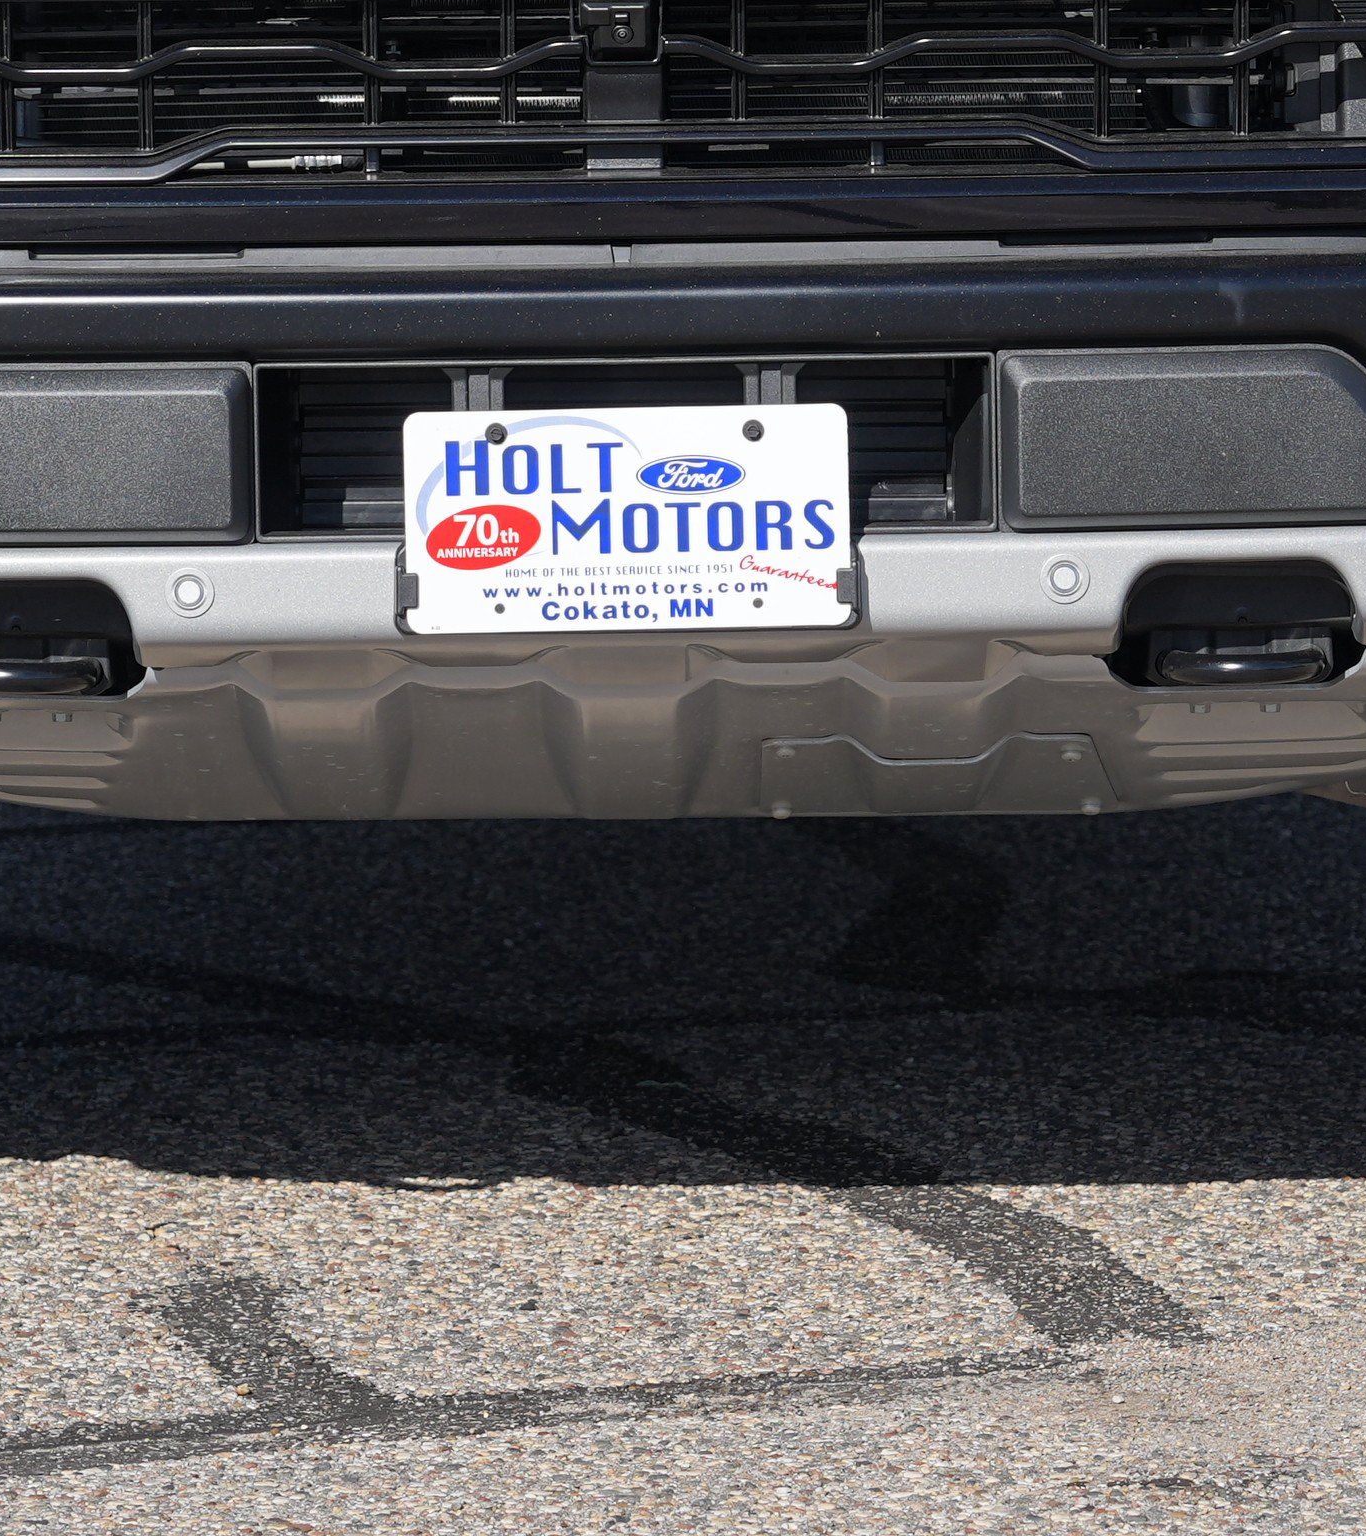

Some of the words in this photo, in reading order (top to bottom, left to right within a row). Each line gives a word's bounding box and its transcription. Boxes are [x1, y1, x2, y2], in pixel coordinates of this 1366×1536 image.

[445, 439, 624, 497] HOLT
[656, 459, 726, 489] Ford
[452, 512, 521, 547] 70th
[551, 498, 836, 556] MOTORS
[436, 546, 520, 560] ANNIVERSARY
[505, 567, 538, 578] HOME
[542, 567, 556, 577] OF
[561, 566, 580, 577] THE
[584, 566, 611, 576] BEST
[615, 565, 663, 576] SERVICE
[667, 564, 702, 575] SINCE
[707, 563, 734, 574] 1951
[482, 581, 769, 599] www.holtmotors.com
[541, 600, 659, 622] Cokato,
[669, 597, 715, 618] MN
